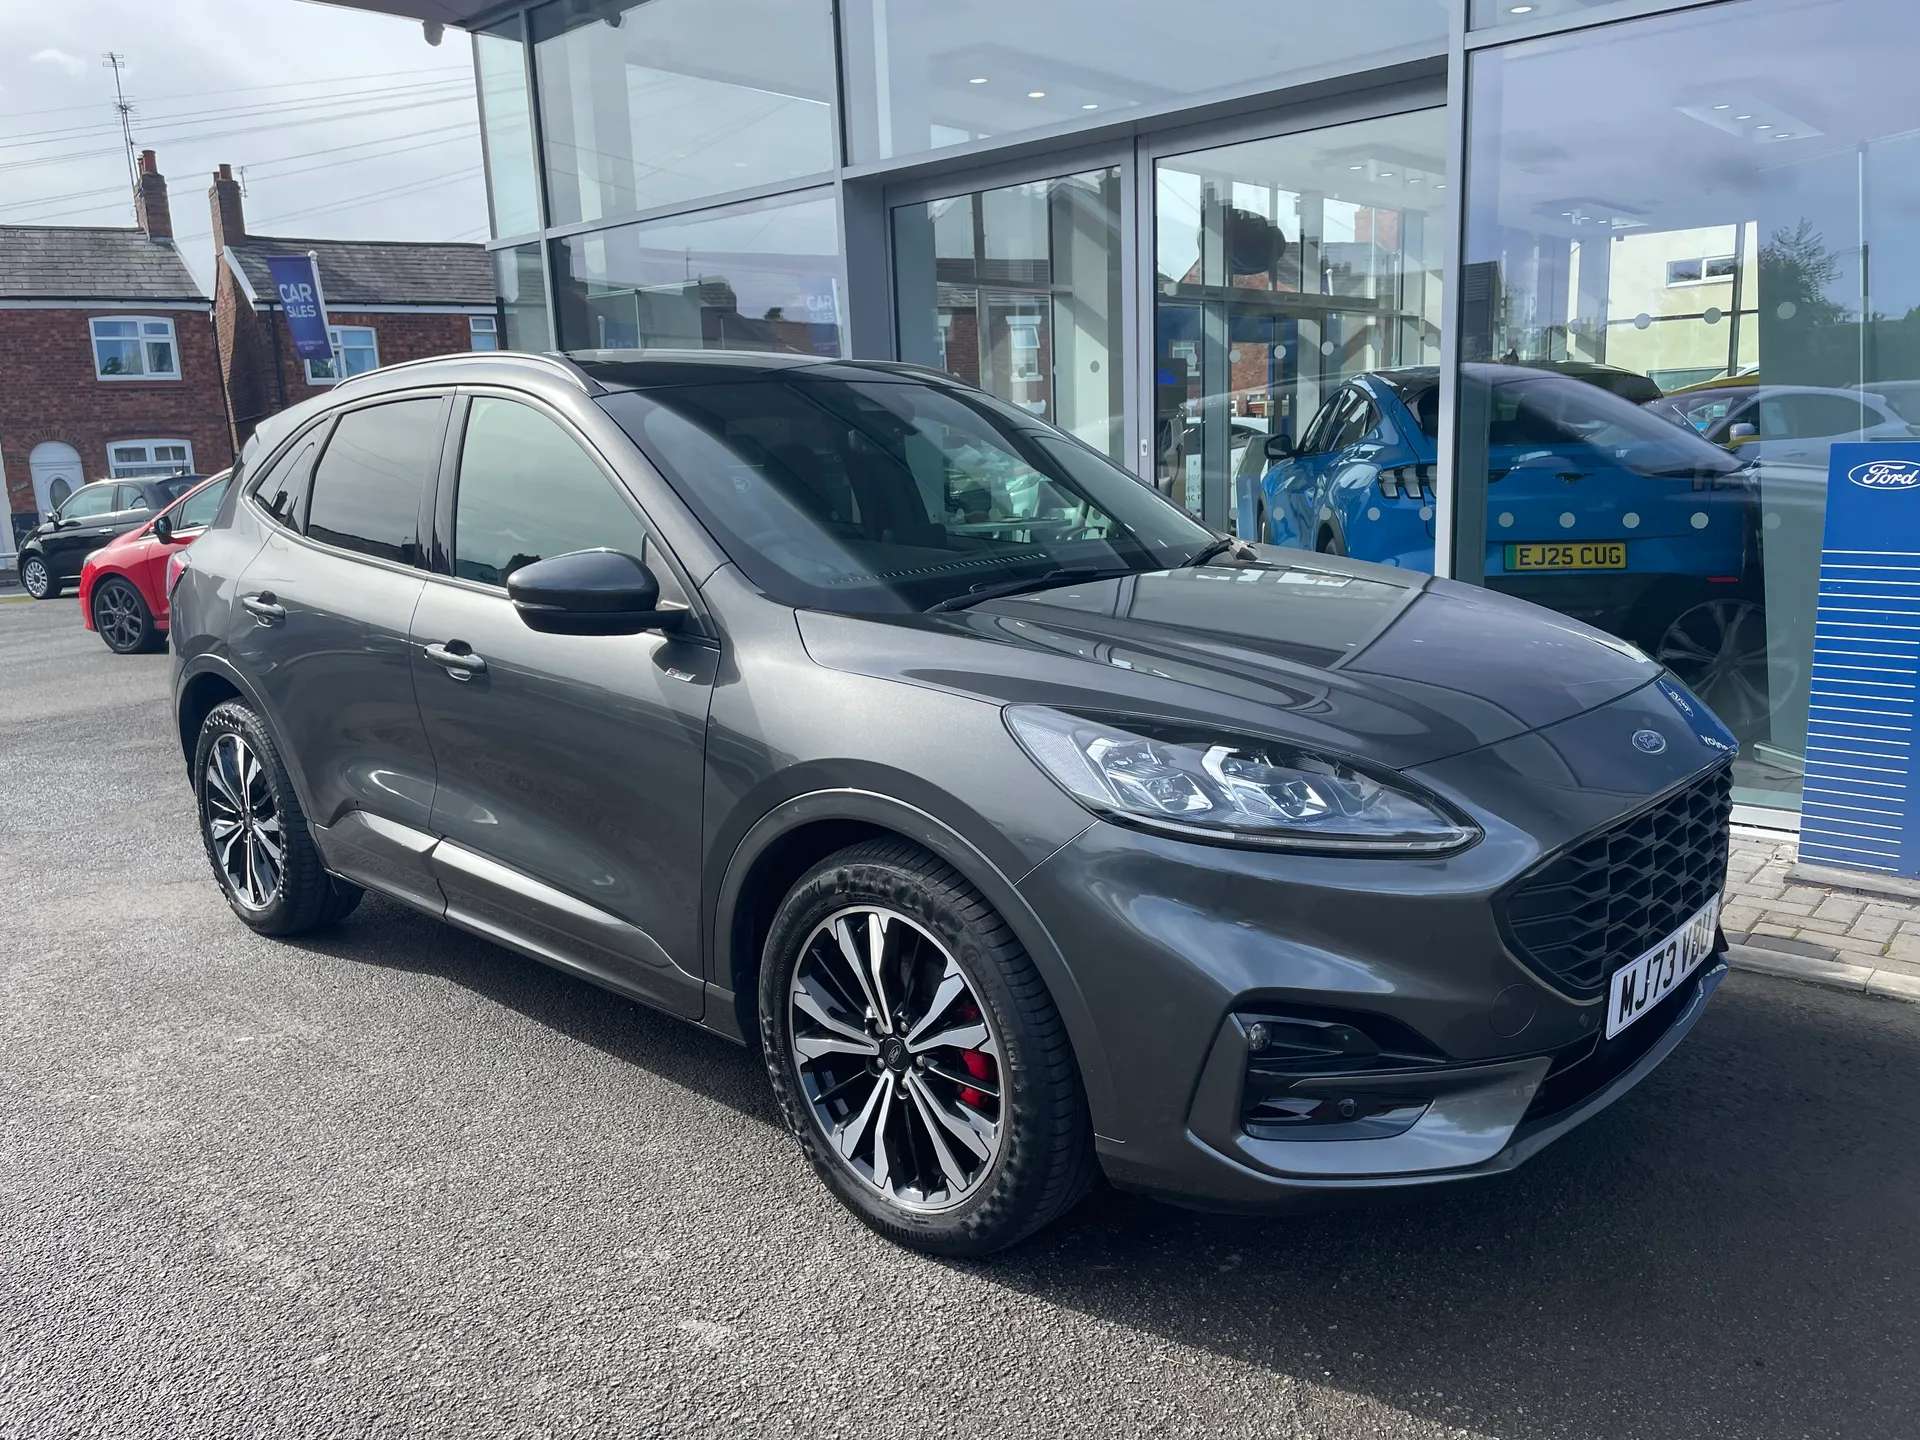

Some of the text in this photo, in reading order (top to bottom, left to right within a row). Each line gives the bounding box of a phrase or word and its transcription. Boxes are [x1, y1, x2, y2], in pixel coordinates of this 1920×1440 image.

[279, 283, 313, 303] CAR
[1862, 464, 1919, 485] Ford
[1519, 546, 1621, 566] EJ25 CUG
[1618, 940, 1678, 1024] MJ73
